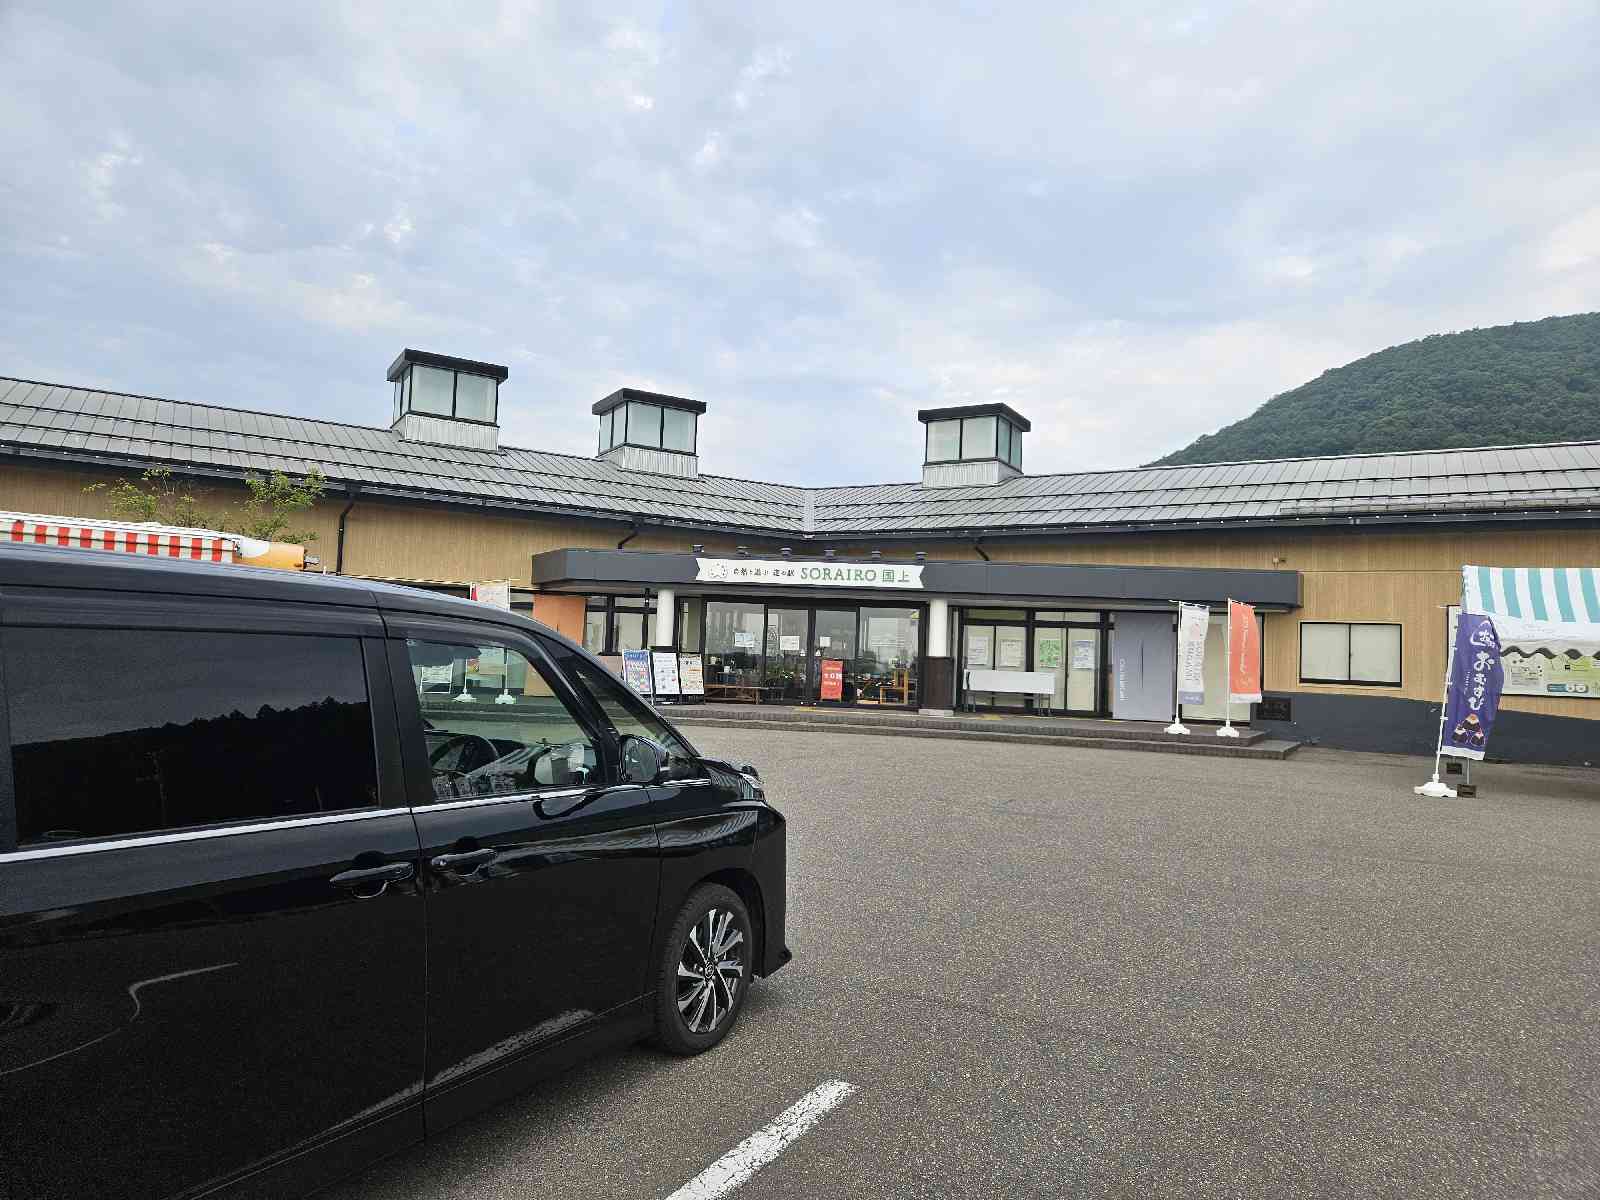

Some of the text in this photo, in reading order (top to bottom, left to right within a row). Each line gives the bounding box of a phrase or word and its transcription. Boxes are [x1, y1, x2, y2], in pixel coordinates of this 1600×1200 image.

[800, 567, 877, 582] SORAIRO
[882, 569, 910, 583] 国上
[1467, 650, 1495, 711] おむすび
